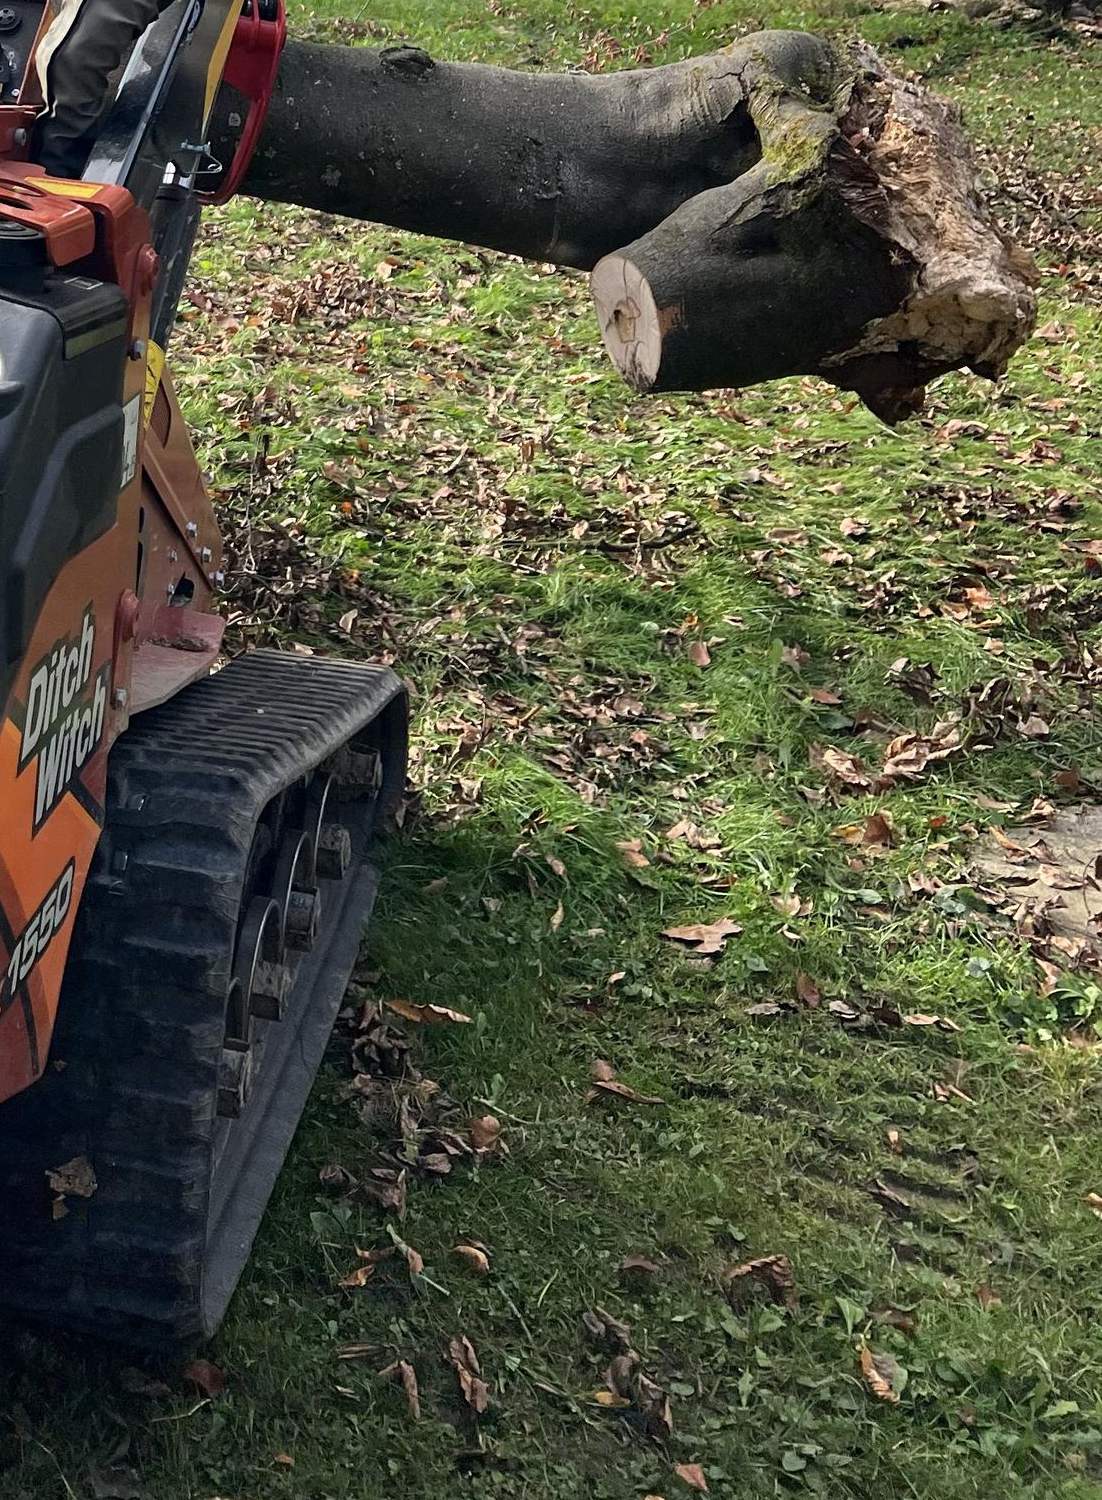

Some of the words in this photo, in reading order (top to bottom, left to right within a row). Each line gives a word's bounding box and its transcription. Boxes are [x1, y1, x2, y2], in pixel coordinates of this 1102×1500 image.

[21, 613, 94, 762] Ditch
[35, 675, 106, 825] Witch
[8, 865, 74, 995] 1550
